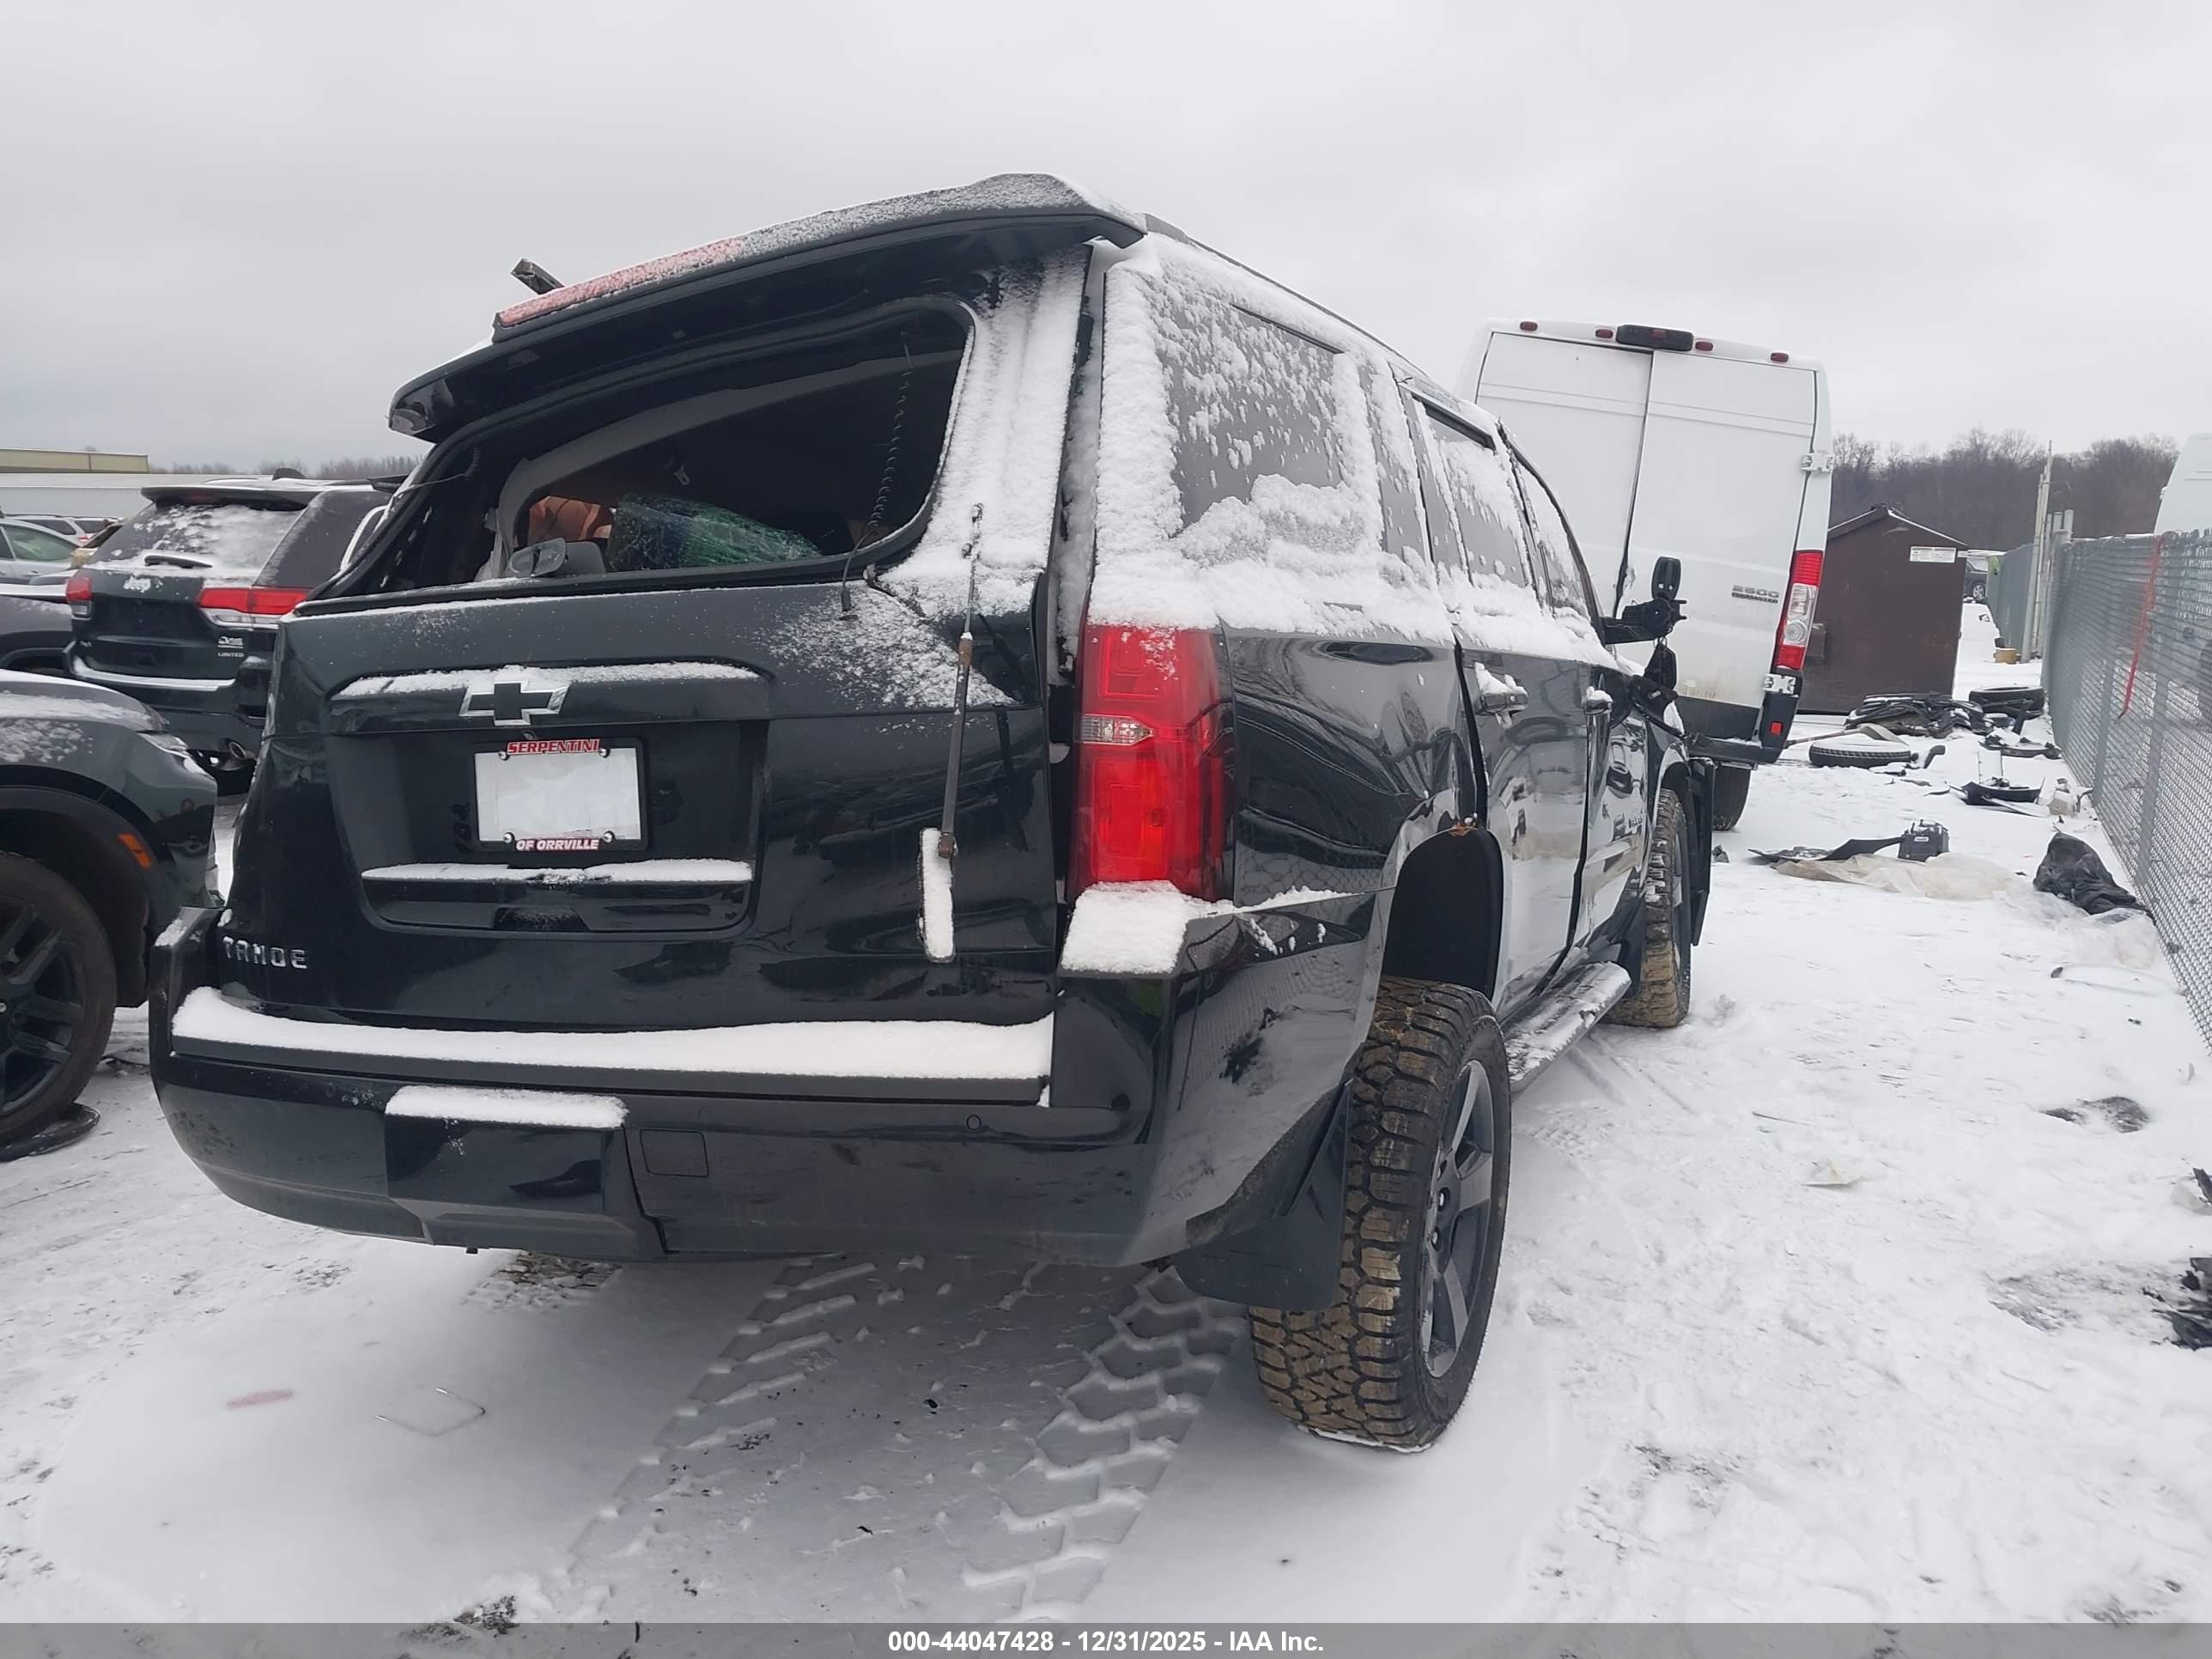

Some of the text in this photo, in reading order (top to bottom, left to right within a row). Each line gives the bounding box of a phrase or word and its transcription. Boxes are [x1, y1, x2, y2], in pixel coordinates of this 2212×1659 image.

[1732, 585, 1779, 598] 2500
[507, 738, 601, 756] SERPENTINI
[516, 838, 599, 851] OF ORRVILLE
[222, 936, 308, 969] TAHOE
